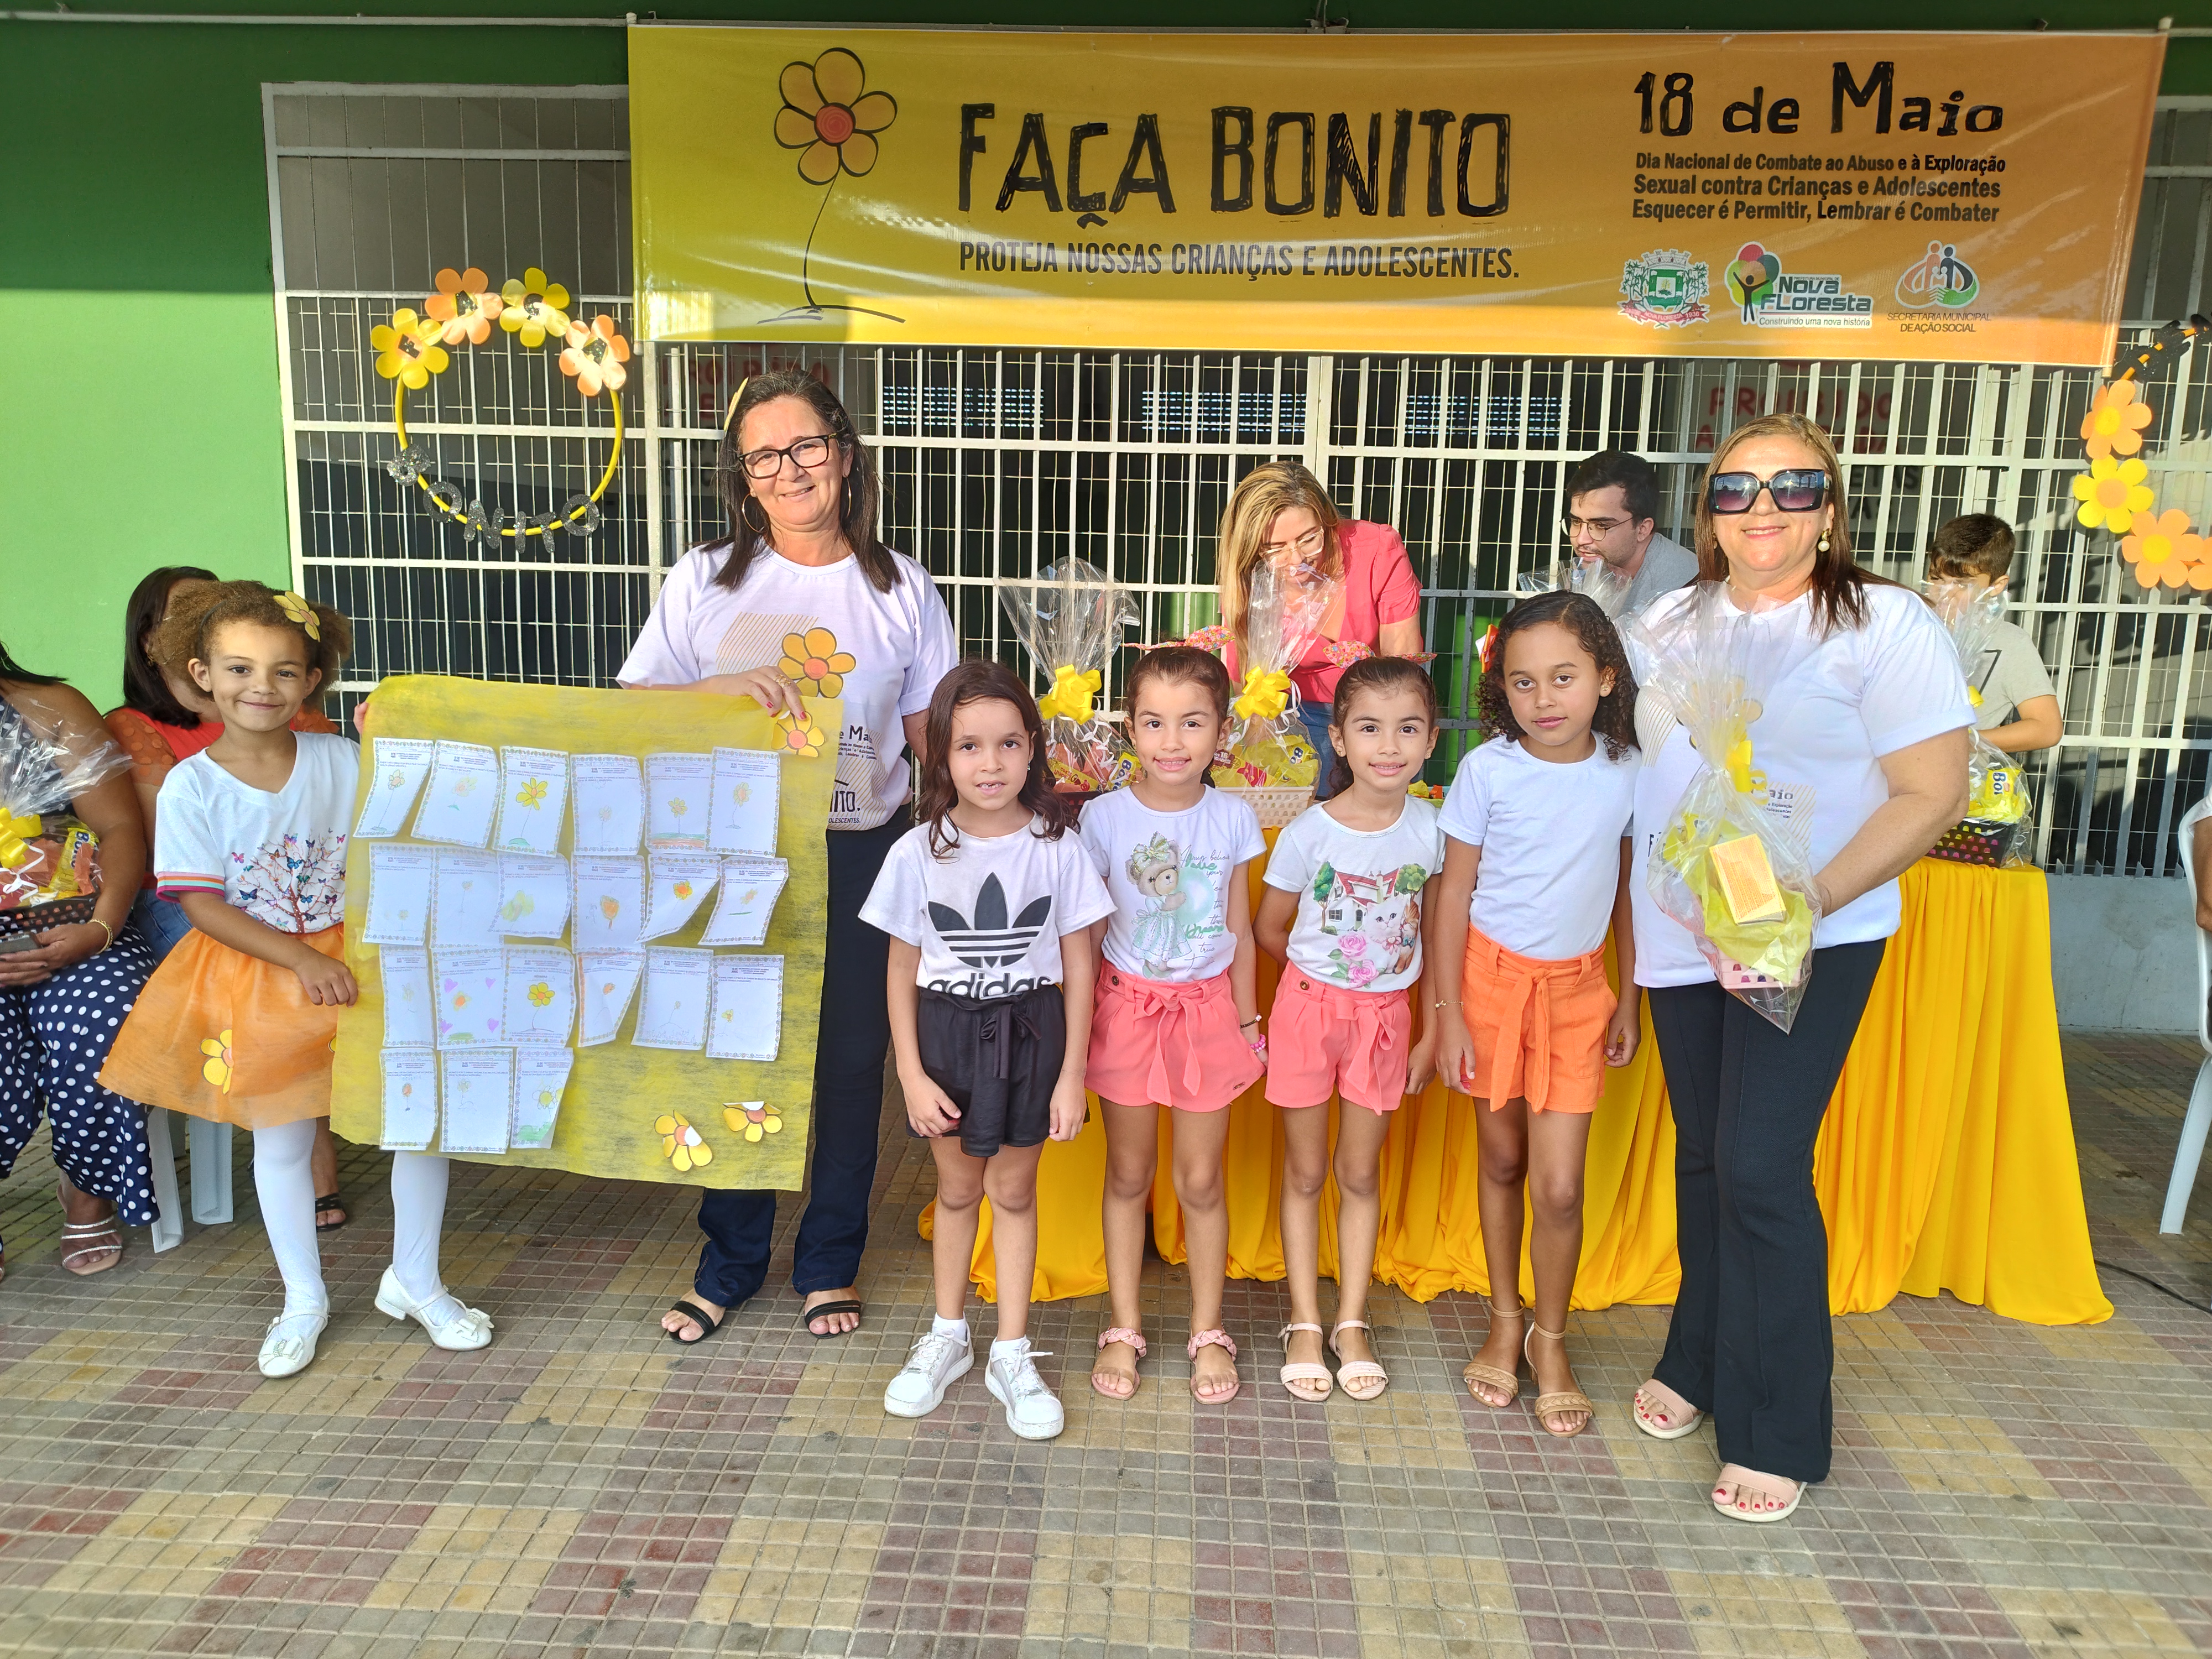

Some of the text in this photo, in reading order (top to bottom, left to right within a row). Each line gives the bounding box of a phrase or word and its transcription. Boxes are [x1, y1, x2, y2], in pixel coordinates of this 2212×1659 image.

[1633, 61, 2003, 136] 18 de Maio
[959, 103, 1510, 229] FAÇA BONITO
[1636, 152, 2006, 176] Dia Nacional de Combate ao Abuso e à Exploração
[1634, 174, 2000, 200] Sexual contra Crianças e Adolescentes
[1632, 199, 2000, 222] Esquecer é Permitir, Lembrar é Combater
[960, 242, 1519, 281] PROTEJA NOSSAS CRIANÇAS E ADOLESCENTES.
[1644, 310, 1658, 319] NOVA
[1760, 317, 1803, 326] Construindo
[1844, 317, 1870, 327] história
[1900, 322, 1977, 334] DE AÇÃO SOCIAL
[387, 444, 600, 554] BONITO
[1769, 789, 1793, 800] aio
